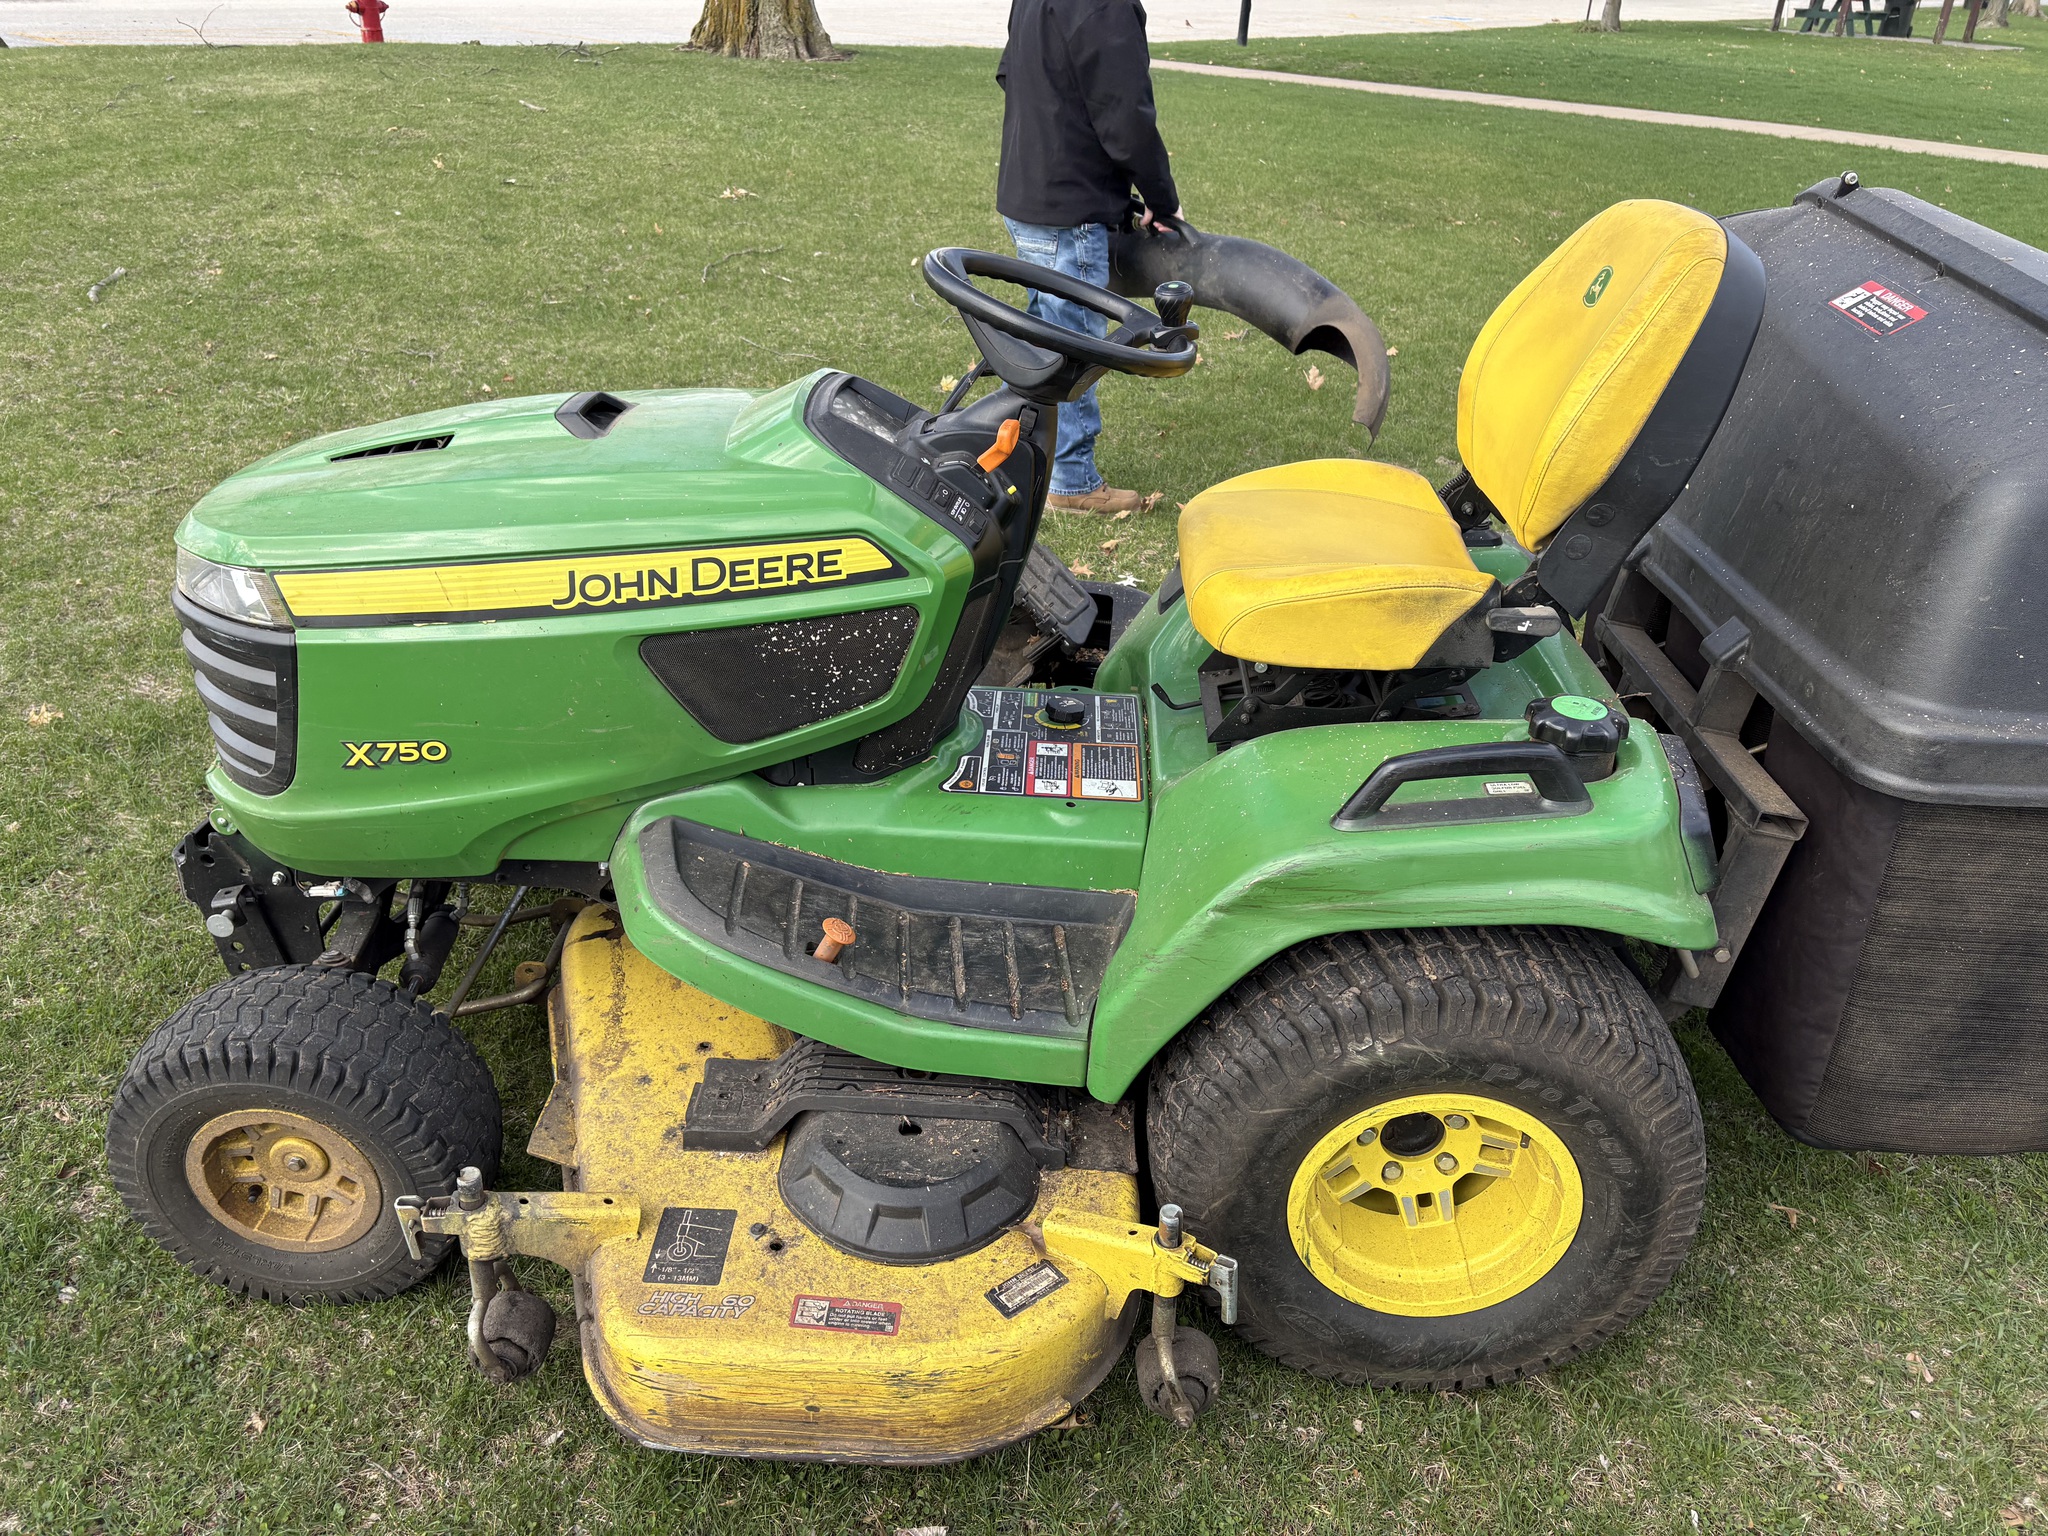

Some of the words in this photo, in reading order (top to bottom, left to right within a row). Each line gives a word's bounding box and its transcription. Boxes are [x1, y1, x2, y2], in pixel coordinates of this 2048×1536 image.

[1882, 291, 1914, 313] DANGER
[552, 566, 678, 605] JOHN
[691, 548, 843, 592] DEERE
[341, 740, 449, 768] X750
[650, 1291, 703, 1305] HIGH
[721, 1294, 756, 1306] 60
[852, 1301, 884, 1310] DANGER
[638, 1302, 750, 1319] CAPACITY
[835, 1308, 865, 1316] ROTATING
